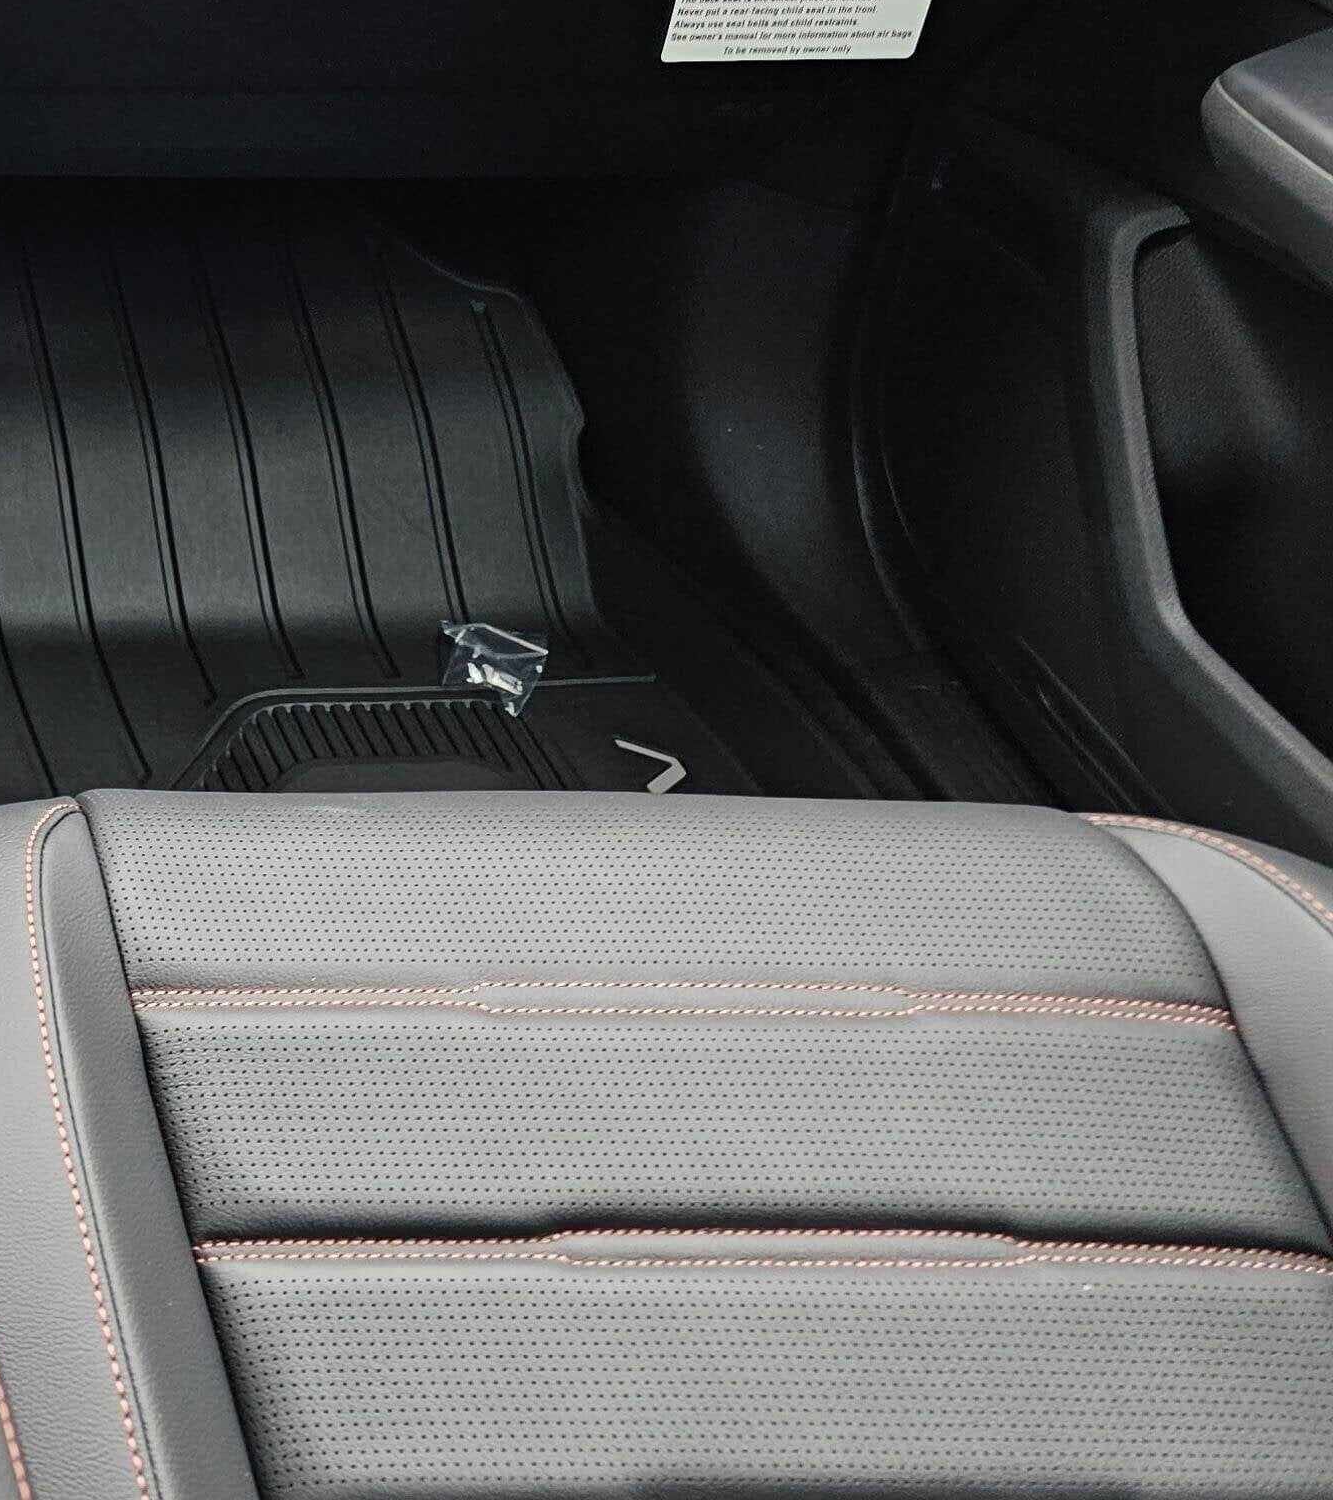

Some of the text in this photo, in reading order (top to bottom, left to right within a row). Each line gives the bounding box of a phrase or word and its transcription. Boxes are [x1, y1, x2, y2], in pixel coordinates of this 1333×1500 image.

[677, 8, 703, 16] Never
[705, 7, 720, 18] put
[782, 7, 804, 15] child
[806, 6, 825, 14] seat
[838, 5, 852, 13] the
[674, 20, 705, 30] Always
[726, 19, 745, 28] seat
[747, 19, 769, 27] belts
[771, 19, 788, 27] and
[790, 18, 813, 26] child
[671, 33, 687, 41] See
[689, 33, 722, 41] owner's
[725, 32, 758, 40] manual
[760, 32, 772, 40] for
[798, 31, 848, 39] information
[724, 46, 733, 55] To
[735, 46, 746, 54] be
[790, 46, 800, 55] by
